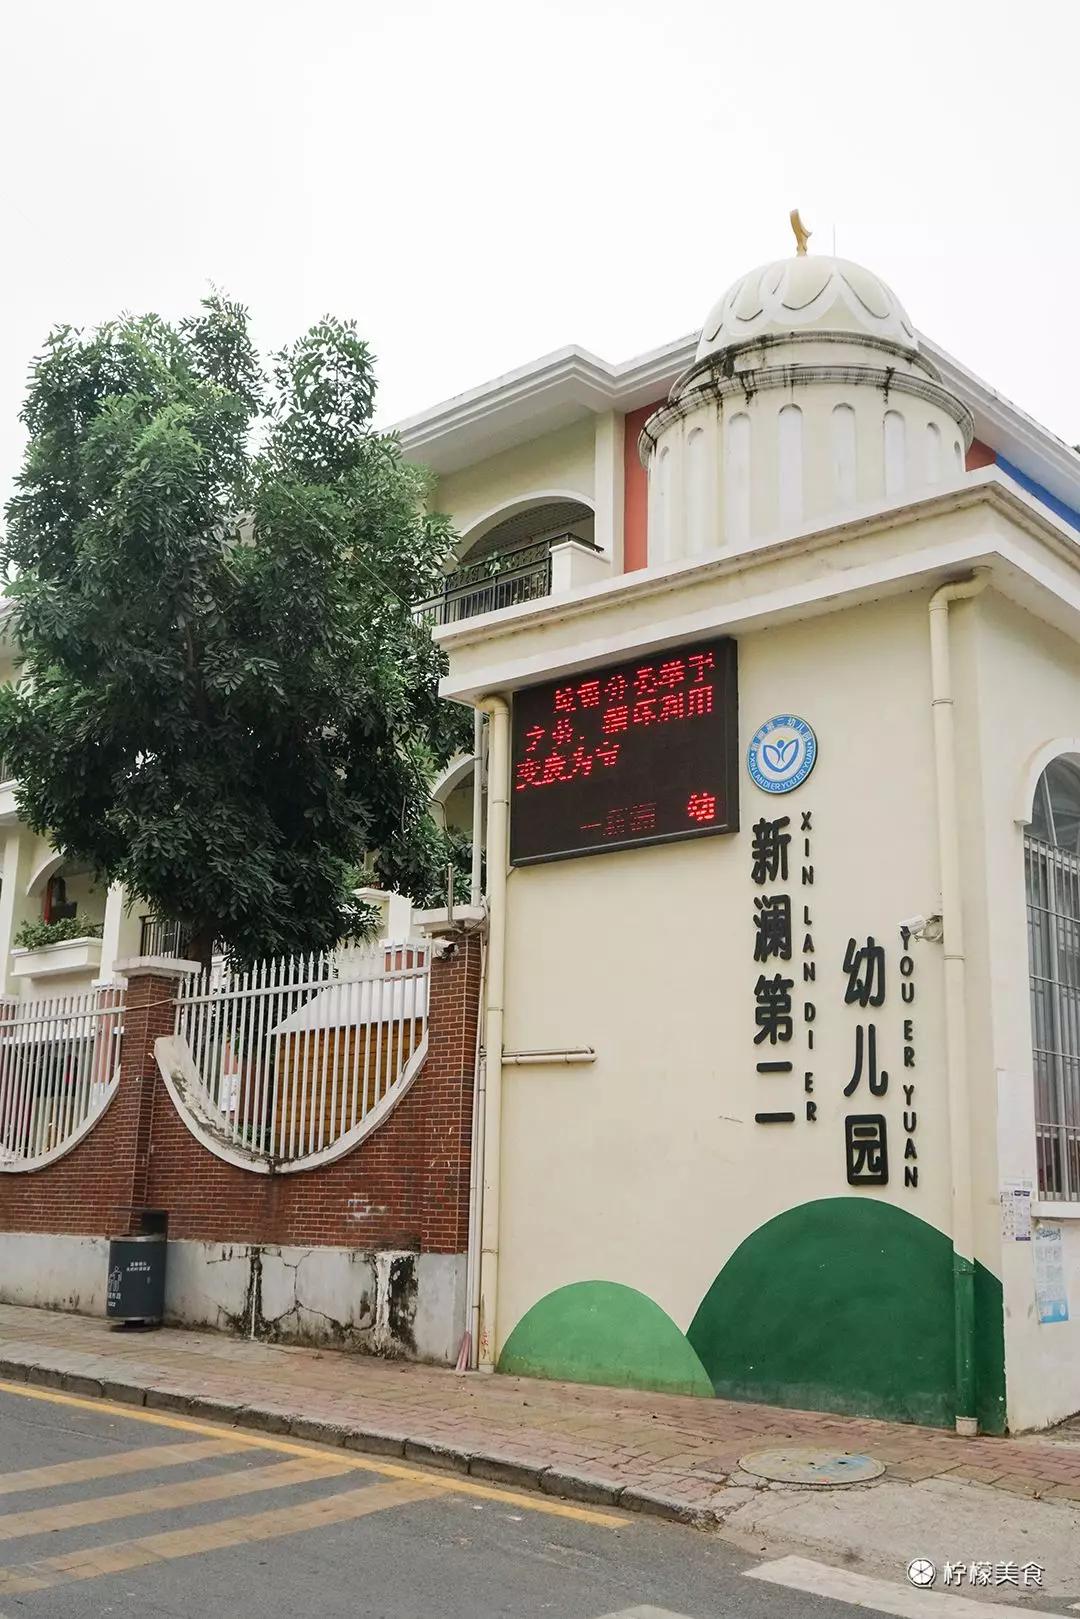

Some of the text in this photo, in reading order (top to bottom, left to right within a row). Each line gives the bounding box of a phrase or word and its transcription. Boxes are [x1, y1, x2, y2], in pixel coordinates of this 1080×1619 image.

[751, 815, 796, 1124] 新澜第二
[799, 810, 818, 1122] XIN LAN DI ER
[842, 935, 890, 1187] 幼儿园
[899, 925, 919, 1189] YOU ER YUAN
